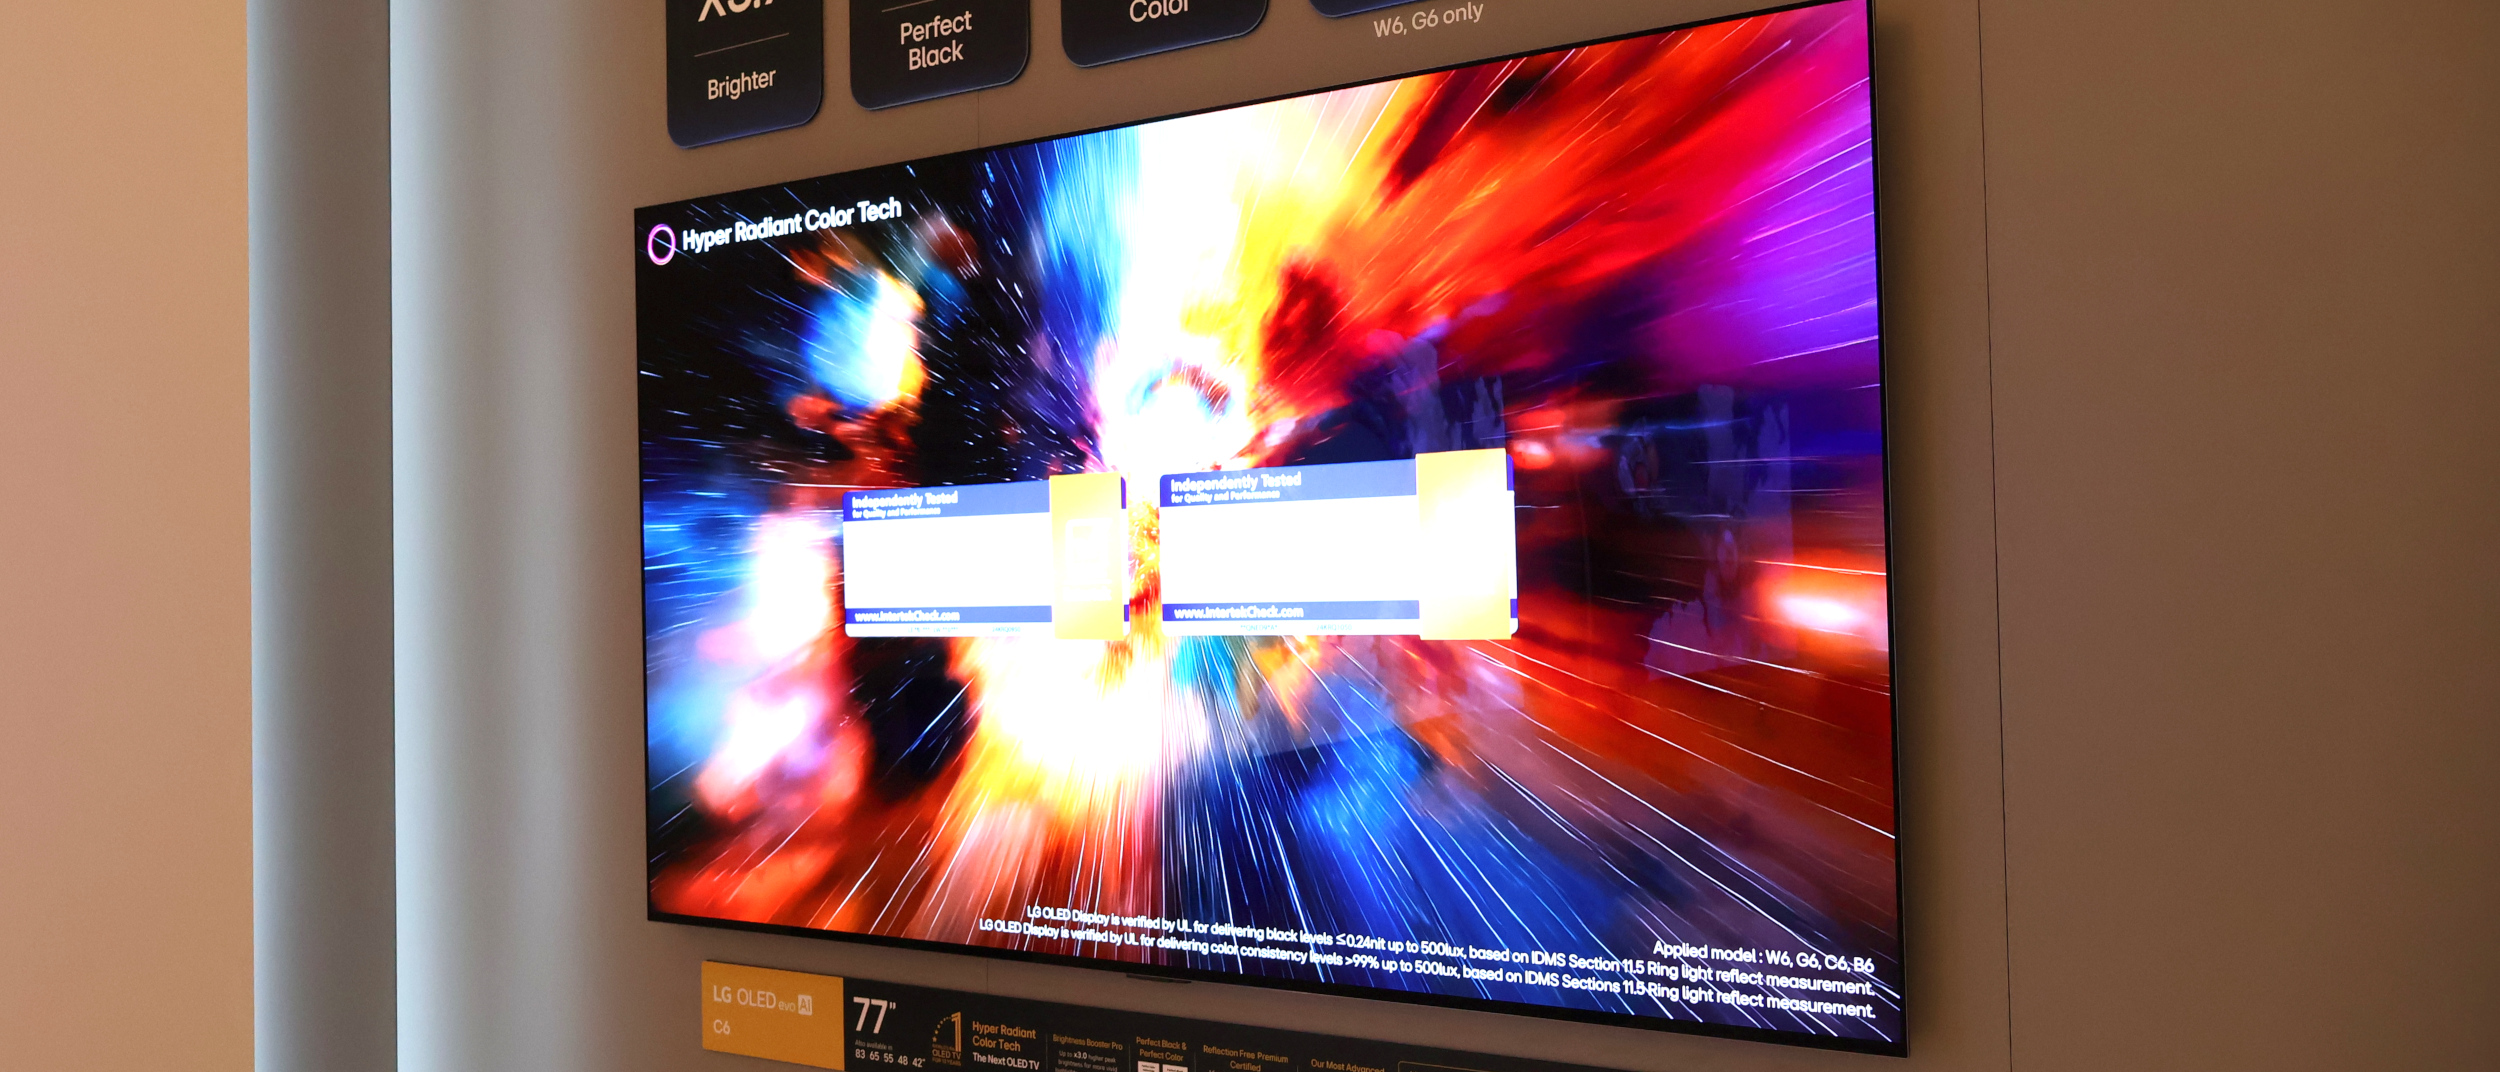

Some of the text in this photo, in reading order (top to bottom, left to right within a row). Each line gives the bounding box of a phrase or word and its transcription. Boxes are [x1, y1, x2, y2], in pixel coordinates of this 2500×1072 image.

[1130, 0, 1188, 23] Color
[1373, 3, 1484, 38] W6, G6 only
[900, 10, 973, 45] Perfect
[908, 40, 964, 71] Black
[708, 68, 776, 100] Brighter
[682, 197, 902, 253] Hyper Radiant Color Tech
[1171, 471, 1302, 493] Independently Tested
[852, 491, 959, 510] Independently Tested
[1027, 905, 1041, 918] LG
[1043, 907, 1071, 921] OLED
[1072, 909, 1110, 927] Display
[1111, 913, 1120, 924] is
[1121, 914, 1160, 930] verified
[1162, 917, 1176, 933] by
[1177, 919, 1192, 933] UL
[1193, 920, 1208, 934] for
[1211, 922, 1265, 942] delivering
[1266, 927, 1298, 943] black
[1300, 930, 1333, 945] levels
[1387, 940, 1404, 954] up
[1405, 940, 1419, 953] to
[1420, 941, 1467, 960] 500lux,
[1469, 945, 1510, 962] based
[1512, 951, 1529, 964] on
[1531, 950, 1566, 967] IDMS
[1569, 954, 1620, 972] Section
[1623, 958, 1645, 975] 11.5
[1647, 960, 1679, 980] Ring
[1681, 964, 1713, 982] light
[1716, 967, 1763, 986] reflect
[1766, 974, 1876, 996] measurement.
[1653, 940, 1708, 959] Applied
[1711, 947, 1756, 963] model
[1765, 950, 1793, 968] W6,
[1796, 952, 1822, 970] G6,
[1825, 954, 1850, 973] C6,
[1854, 956, 1875, 973] B6
[979, 918, 1876, 1019] LG OLED Display is verified by UL for delivering color consistency levels >99% up to 500lux, based on IDMS Sections 11.5 Ring light reflect measurement.
[713, 985, 812, 1015] LG OLED evo AI
[713, 1018, 731, 1035] C6
[972, 1021, 1036, 1040] Hyper Radiant
[972, 1035, 1021, 1052] Color Tech
[1053, 1034, 1123, 1051] Brightness Booster Pro
[1136, 1036, 1187, 1050] Perfect Black &
[855, 1048, 866, 1059] 83
[869, 1050, 880, 1061] 65
[883, 1052, 894, 1064] 55
[897, 1054, 909, 1065] 48
[932, 1048, 961, 1060] OLED TV
[972, 1052, 1040, 1070] The Next OLED TV
[1139, 1049, 1184, 1062] Perfect Color
[1203, 1045, 1289, 1063] Reflection Free Premium
[1230, 1060, 1262, 1072] Certified
[1311, 1059, 1325, 1069] Our
[1326, 1061, 1345, 1071] Most
